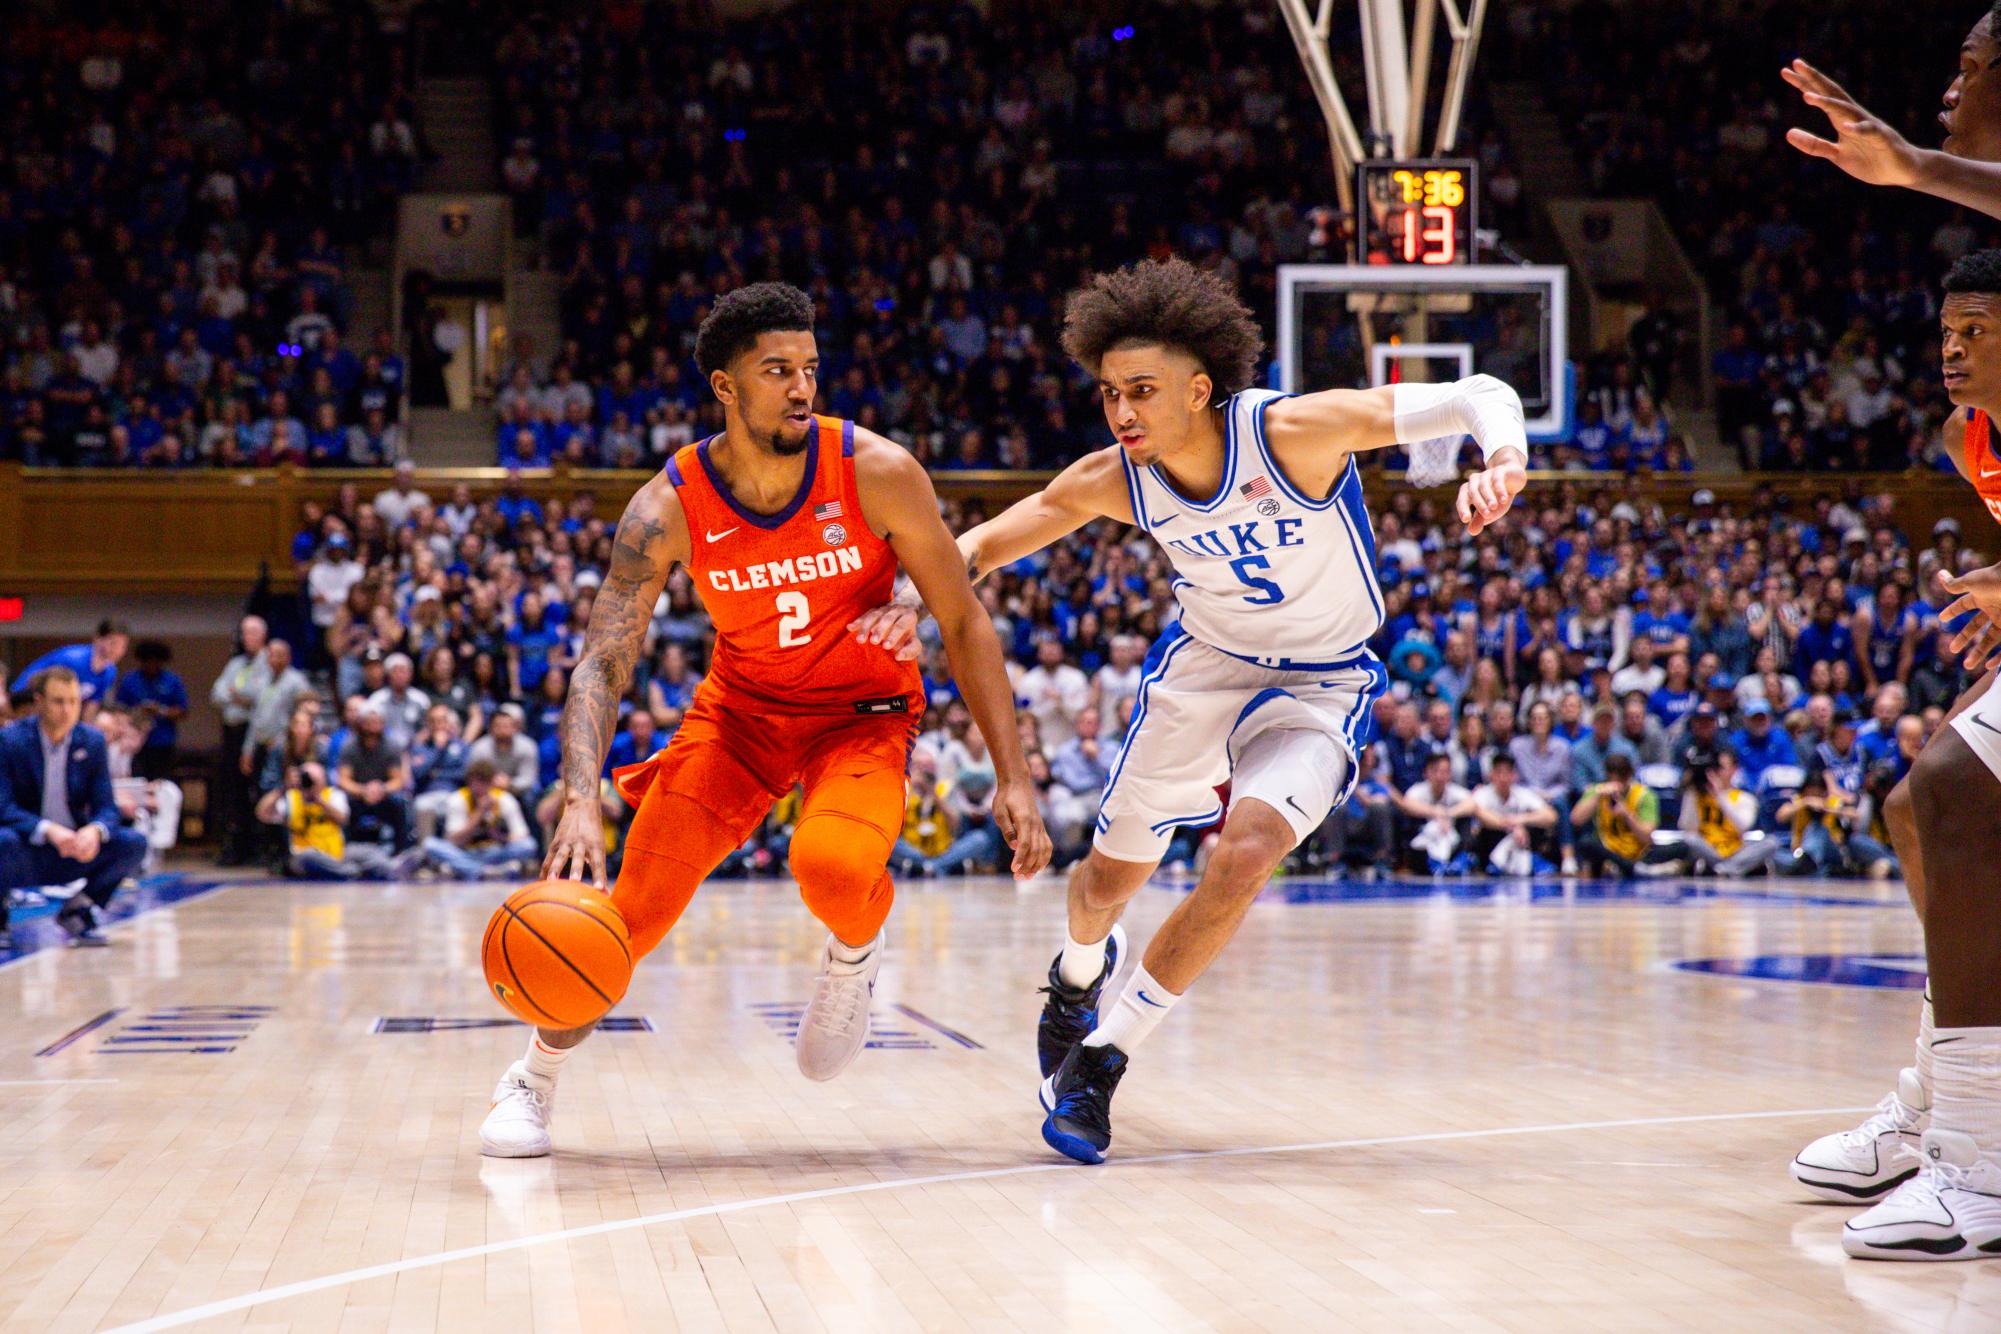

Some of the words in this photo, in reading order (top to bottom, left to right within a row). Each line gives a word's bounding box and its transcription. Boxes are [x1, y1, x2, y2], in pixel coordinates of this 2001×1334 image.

[1393, 170, 1464, 207] 7:36
[1403, 205, 1455, 265] 13
[708, 545, 863, 592] CLEMSON
[1228, 554, 1285, 605] 5
[775, 590, 812, 648] 2
